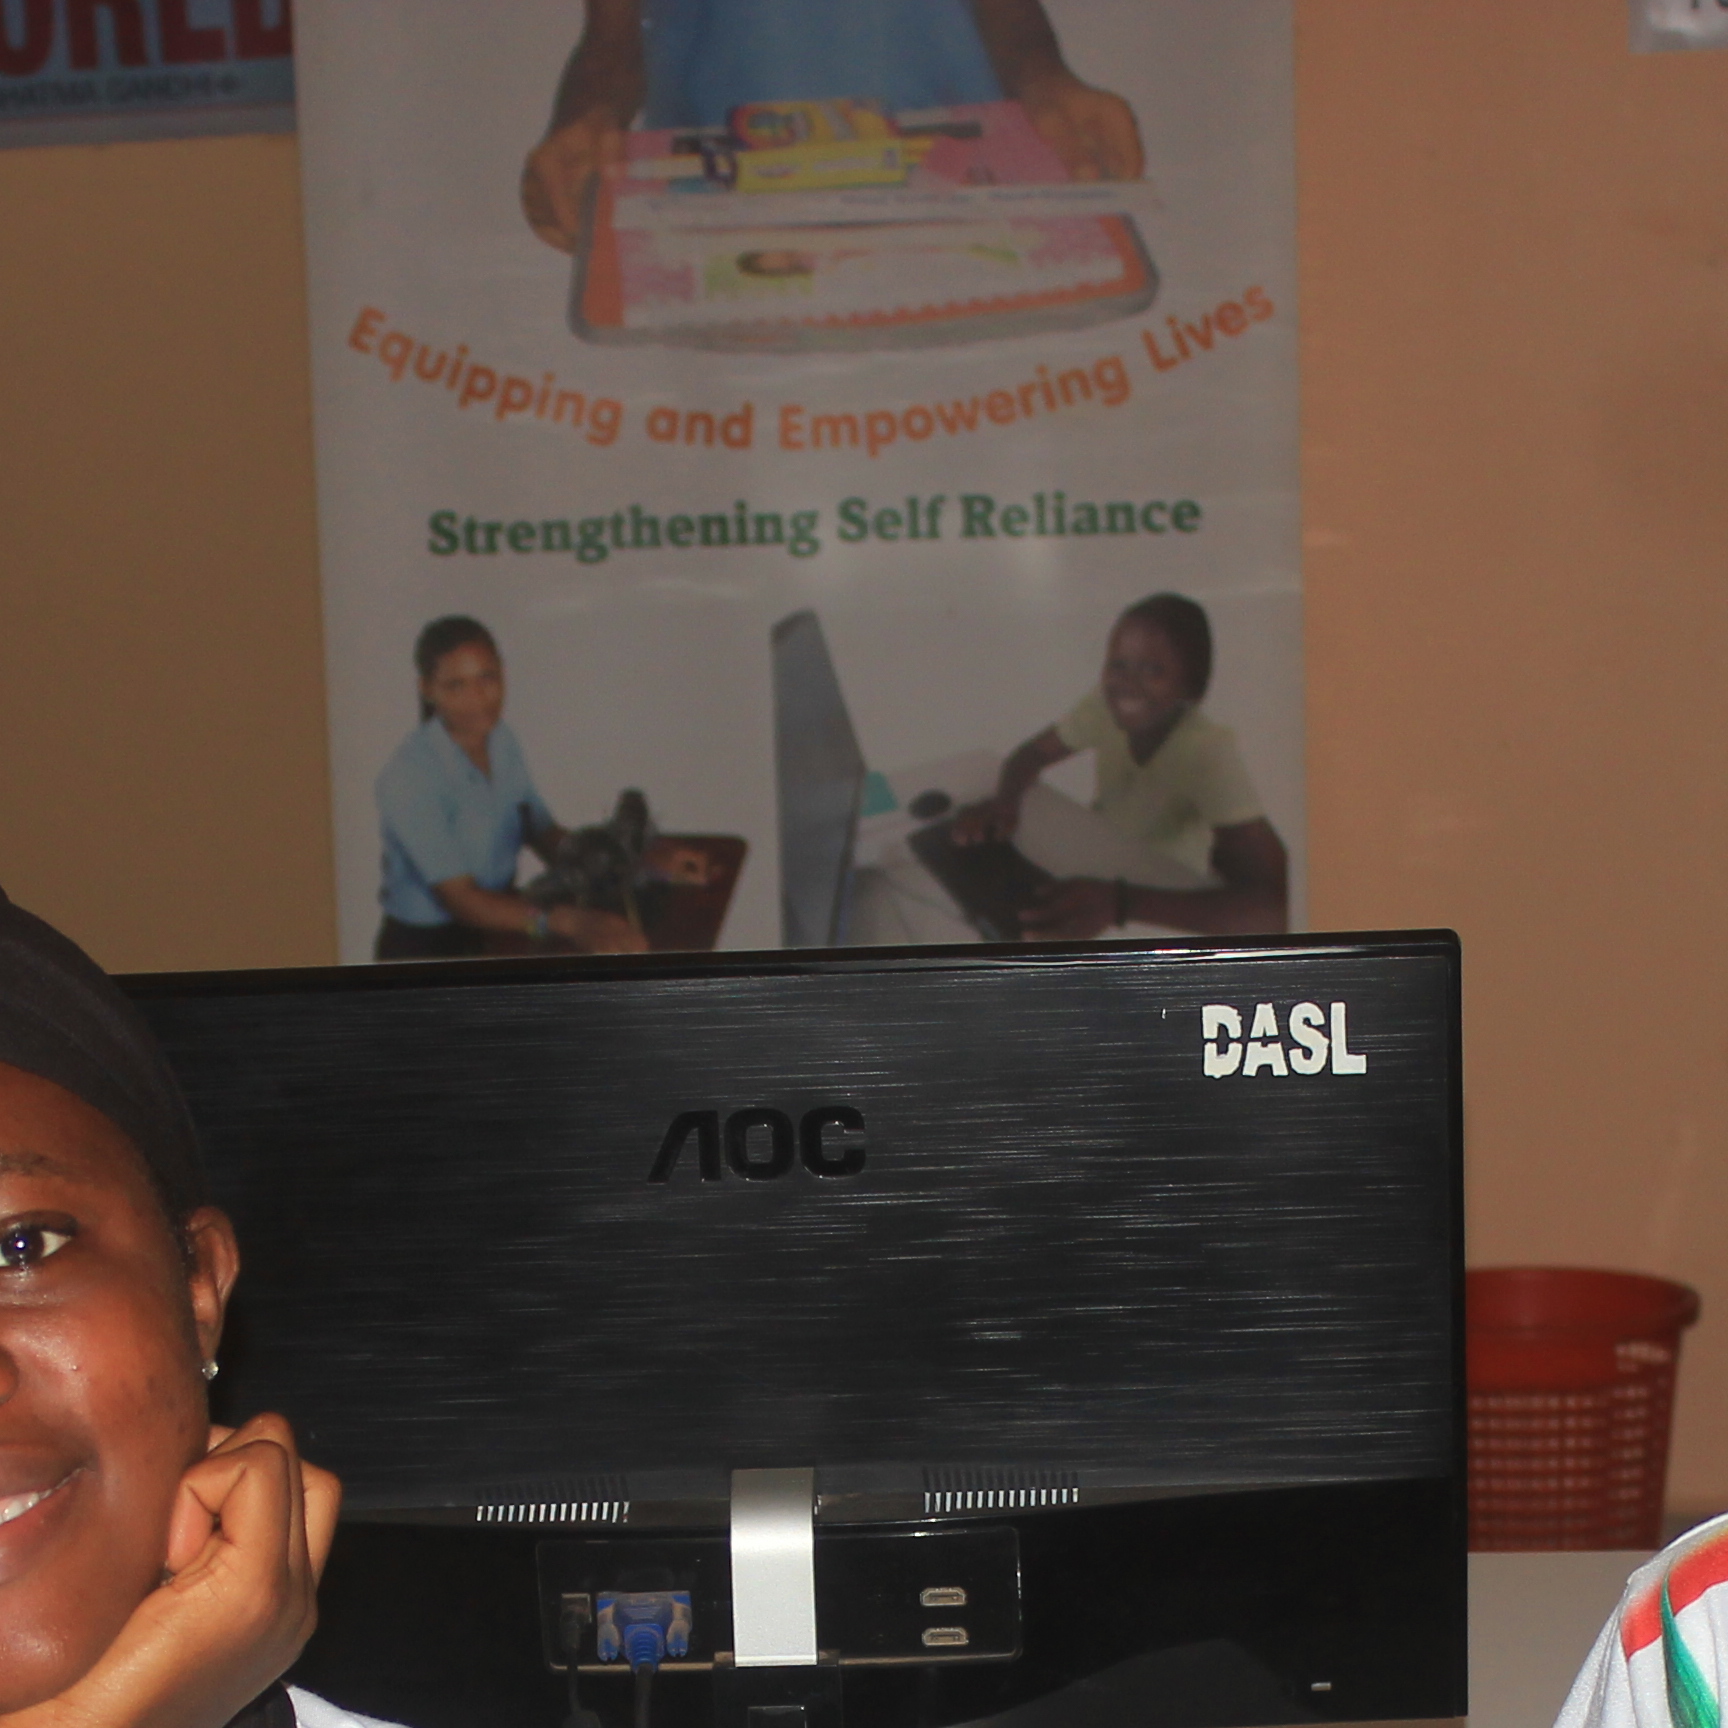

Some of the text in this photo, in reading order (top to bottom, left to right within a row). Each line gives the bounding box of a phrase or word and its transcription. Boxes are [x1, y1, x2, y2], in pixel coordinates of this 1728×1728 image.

[348, 285, 1275, 459] Equipping and Empowering Lives
[428, 491, 1203, 565] Strengthening Self Reliance
[1201, 1001, 1367, 1079] DASL
[646, 1105, 867, 1186] AOC
